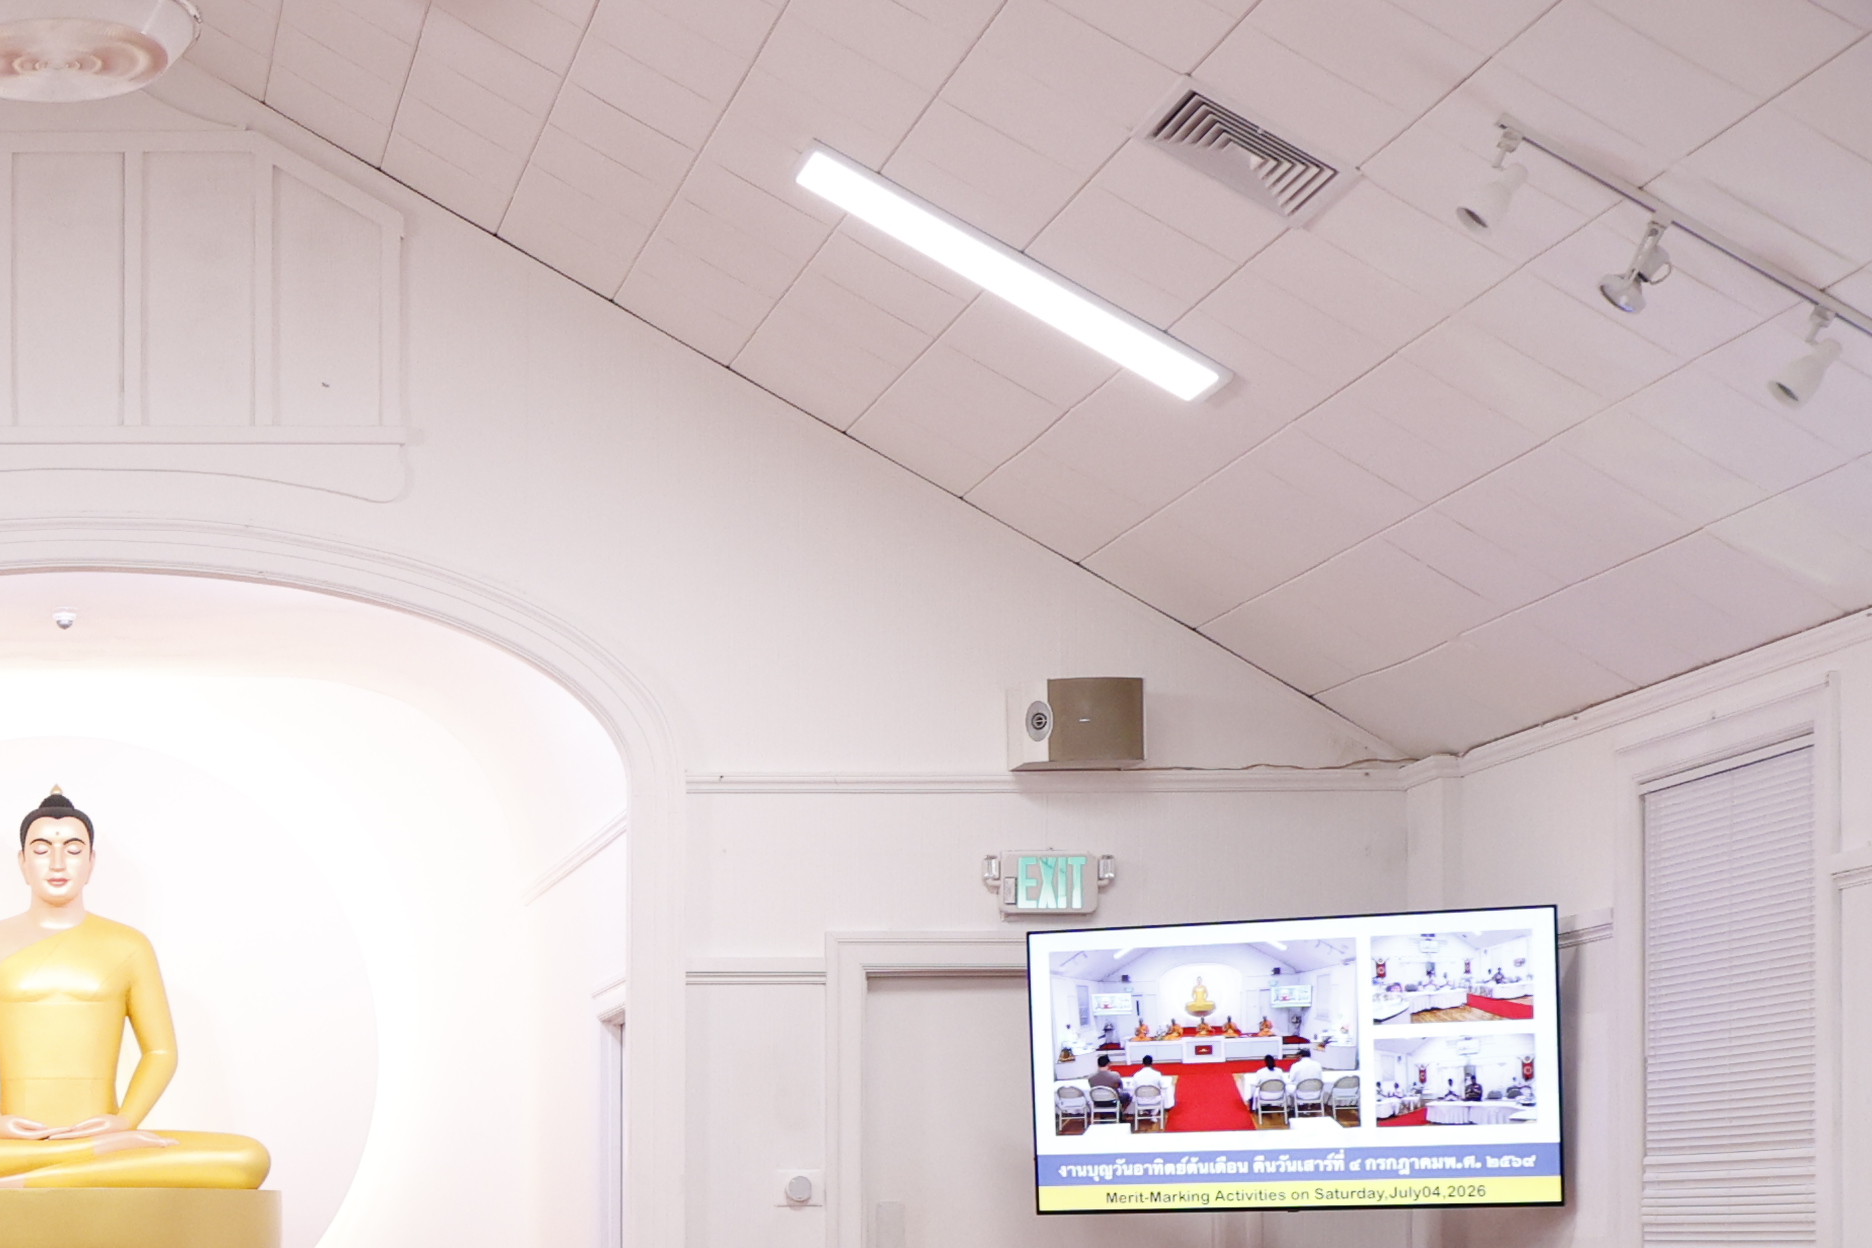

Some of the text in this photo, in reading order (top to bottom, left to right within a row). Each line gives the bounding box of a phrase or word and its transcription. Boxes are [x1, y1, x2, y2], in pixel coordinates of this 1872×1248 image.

[1017, 855, 1088, 909] EXIT
[1105, 1190, 1210, 1205] Merit-Marking
[1214, 1188, 1286, 1202] Activities
[1291, 1190, 1310, 1201] on
